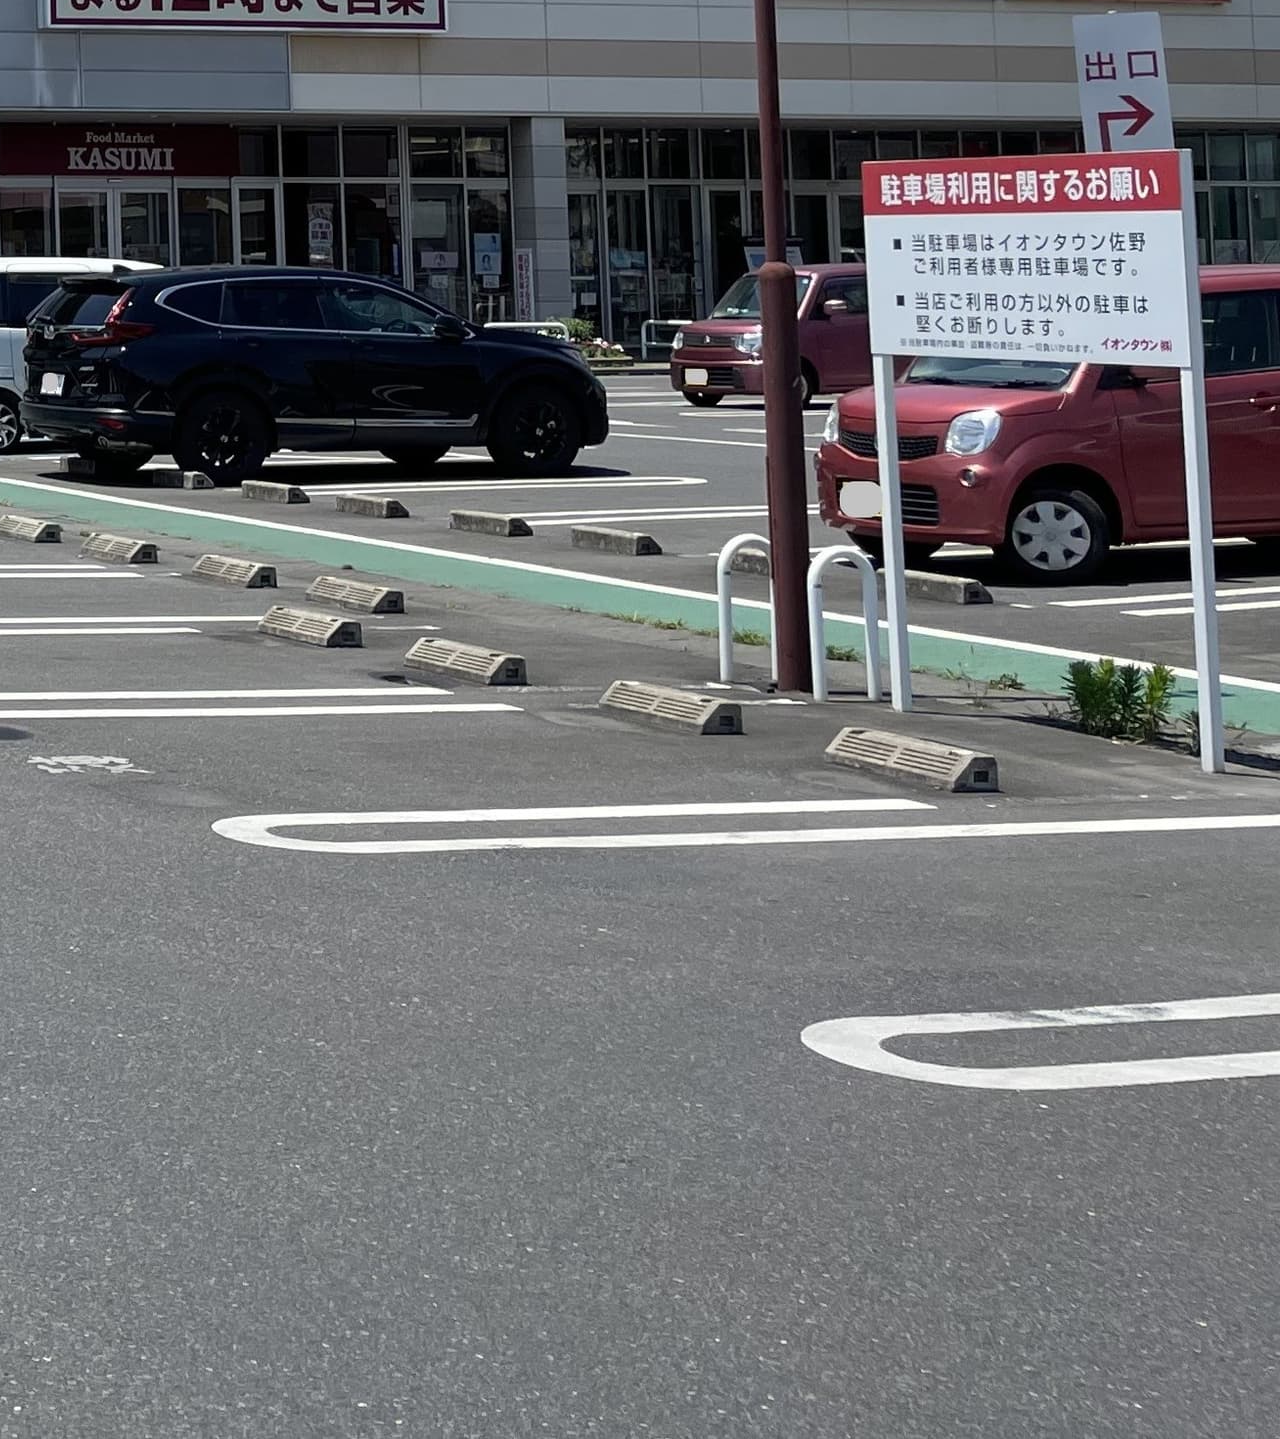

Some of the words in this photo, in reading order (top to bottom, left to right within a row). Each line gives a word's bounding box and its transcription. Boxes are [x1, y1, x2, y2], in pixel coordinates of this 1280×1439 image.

[1084, 50, 1159, 82] 出口
[85, 131, 113, 143] Food
[114, 132, 155, 144] Market
[66, 147, 175, 170] KASUMI
[880, 166, 1160, 207] 駐車場利用に関するお願い
[910, 231, 1146, 253] 当駐車場はイオンタウン佐野
[913, 256, 1139, 277] ご利用者様専用駐車場です。
[914, 292, 1150, 314] 当店ご利用の方以外の駐車は
[916, 314, 1066, 337] 堅くお断りします。
